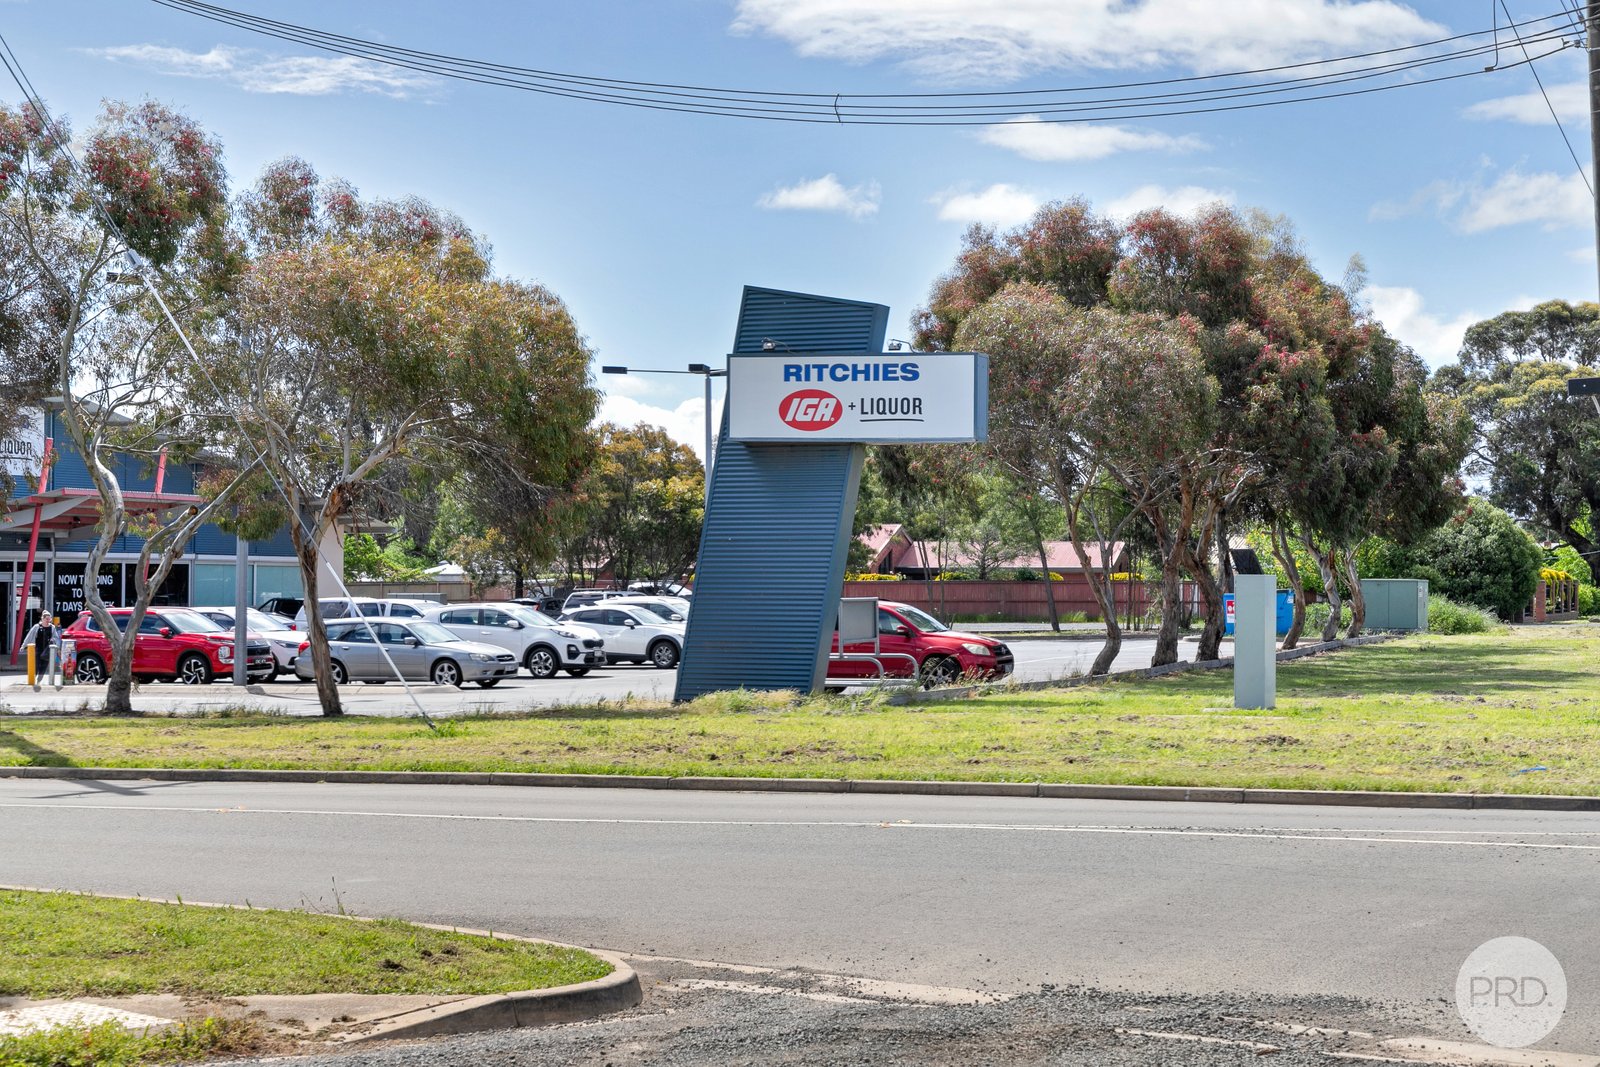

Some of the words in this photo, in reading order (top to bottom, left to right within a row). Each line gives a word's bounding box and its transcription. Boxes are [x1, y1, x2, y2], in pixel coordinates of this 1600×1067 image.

[784, 363, 920, 382] RITCHIES
[860, 397, 923, 415] LIQUOR
[58, 574, 78, 585] NOW
[79, 574, 113, 585] TDING
[72, 588, 83, 598] TO
[56, 601, 61, 612] 7
[62, 601, 83, 612] DAYS
